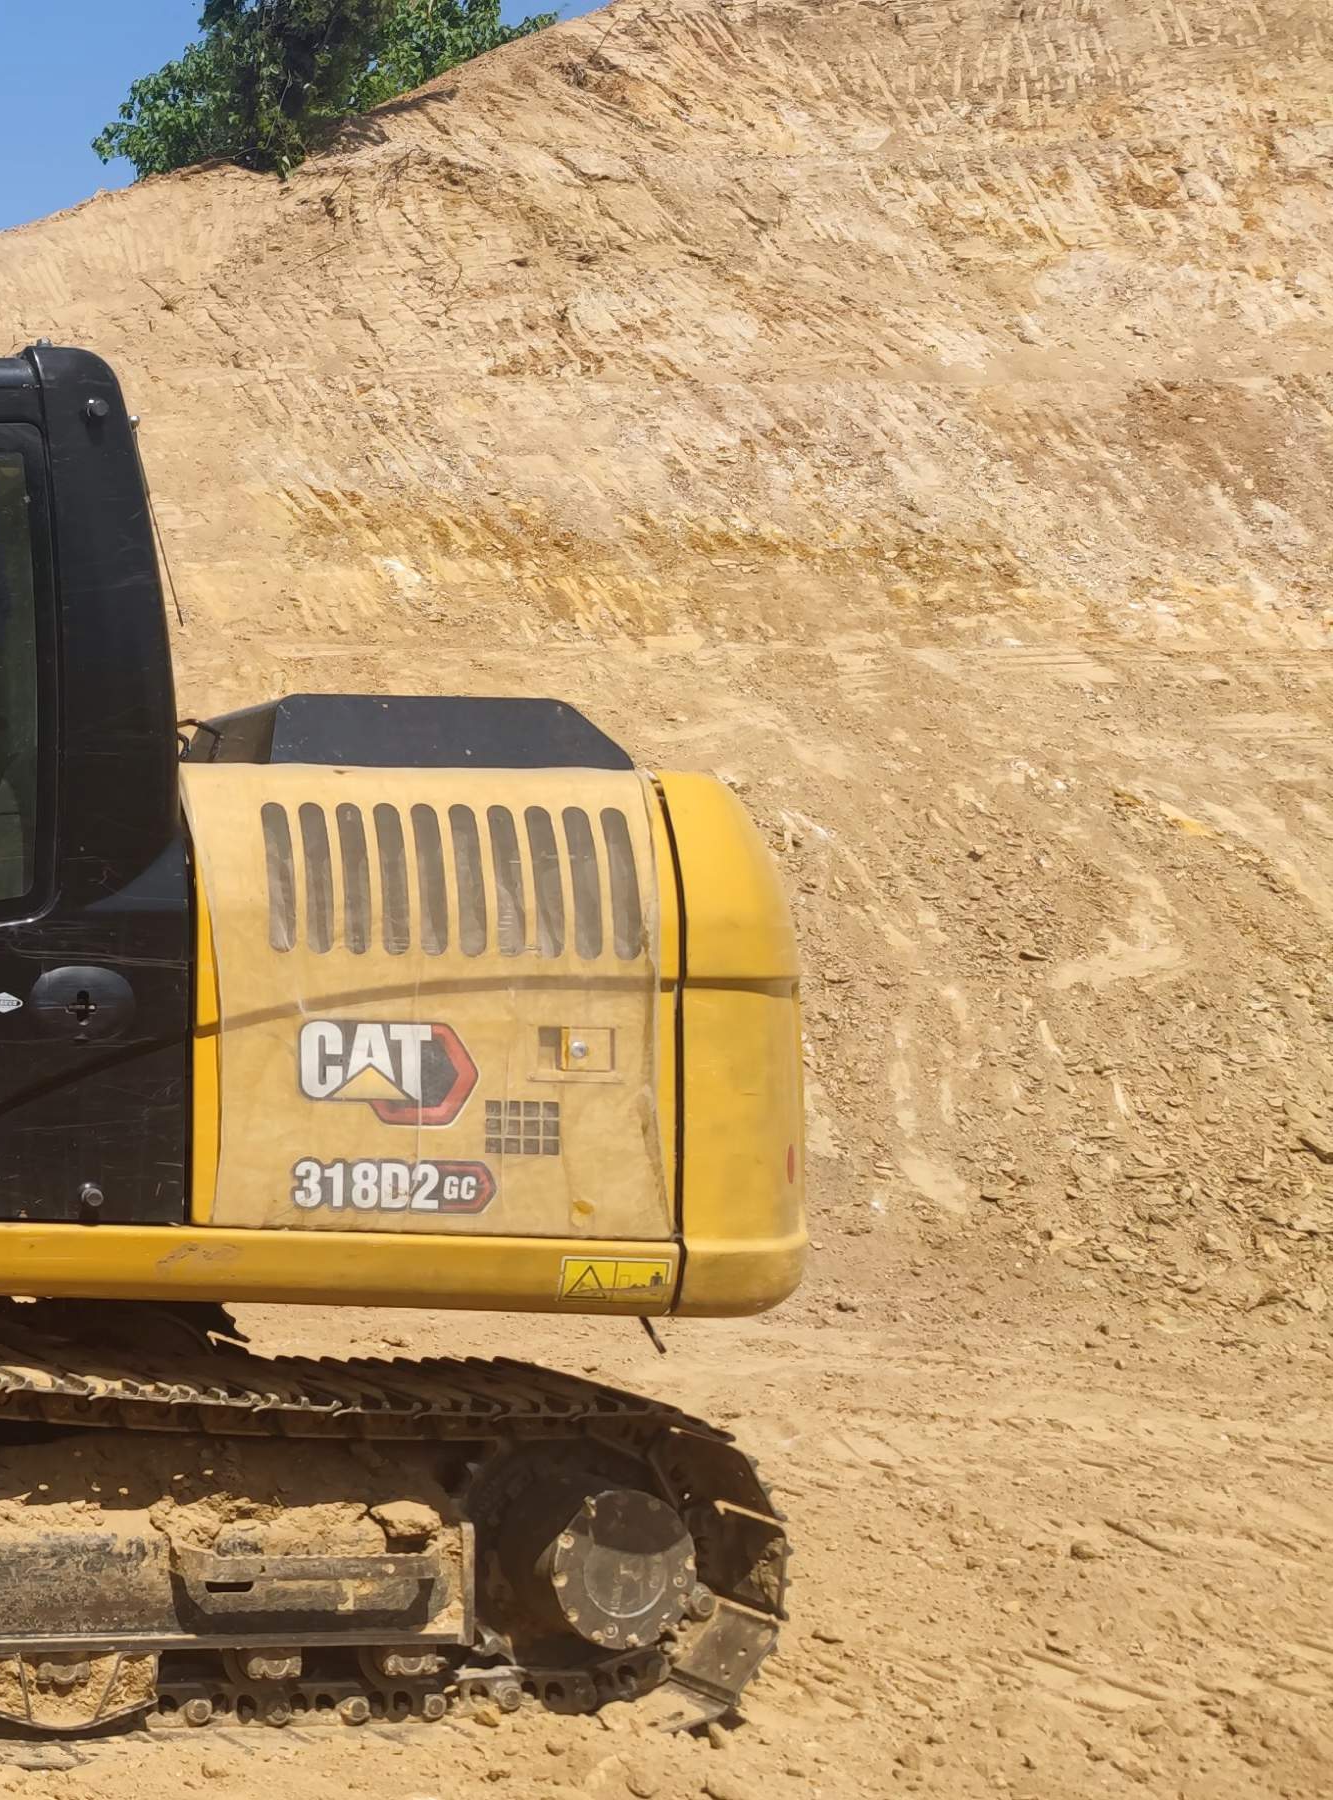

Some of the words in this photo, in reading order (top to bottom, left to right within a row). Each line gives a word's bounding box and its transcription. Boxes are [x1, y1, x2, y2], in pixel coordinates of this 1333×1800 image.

[300, 1021, 433, 1102] CAT
[293, 1160, 439, 1211] 318D2
[442, 1176, 477, 1202] GC
